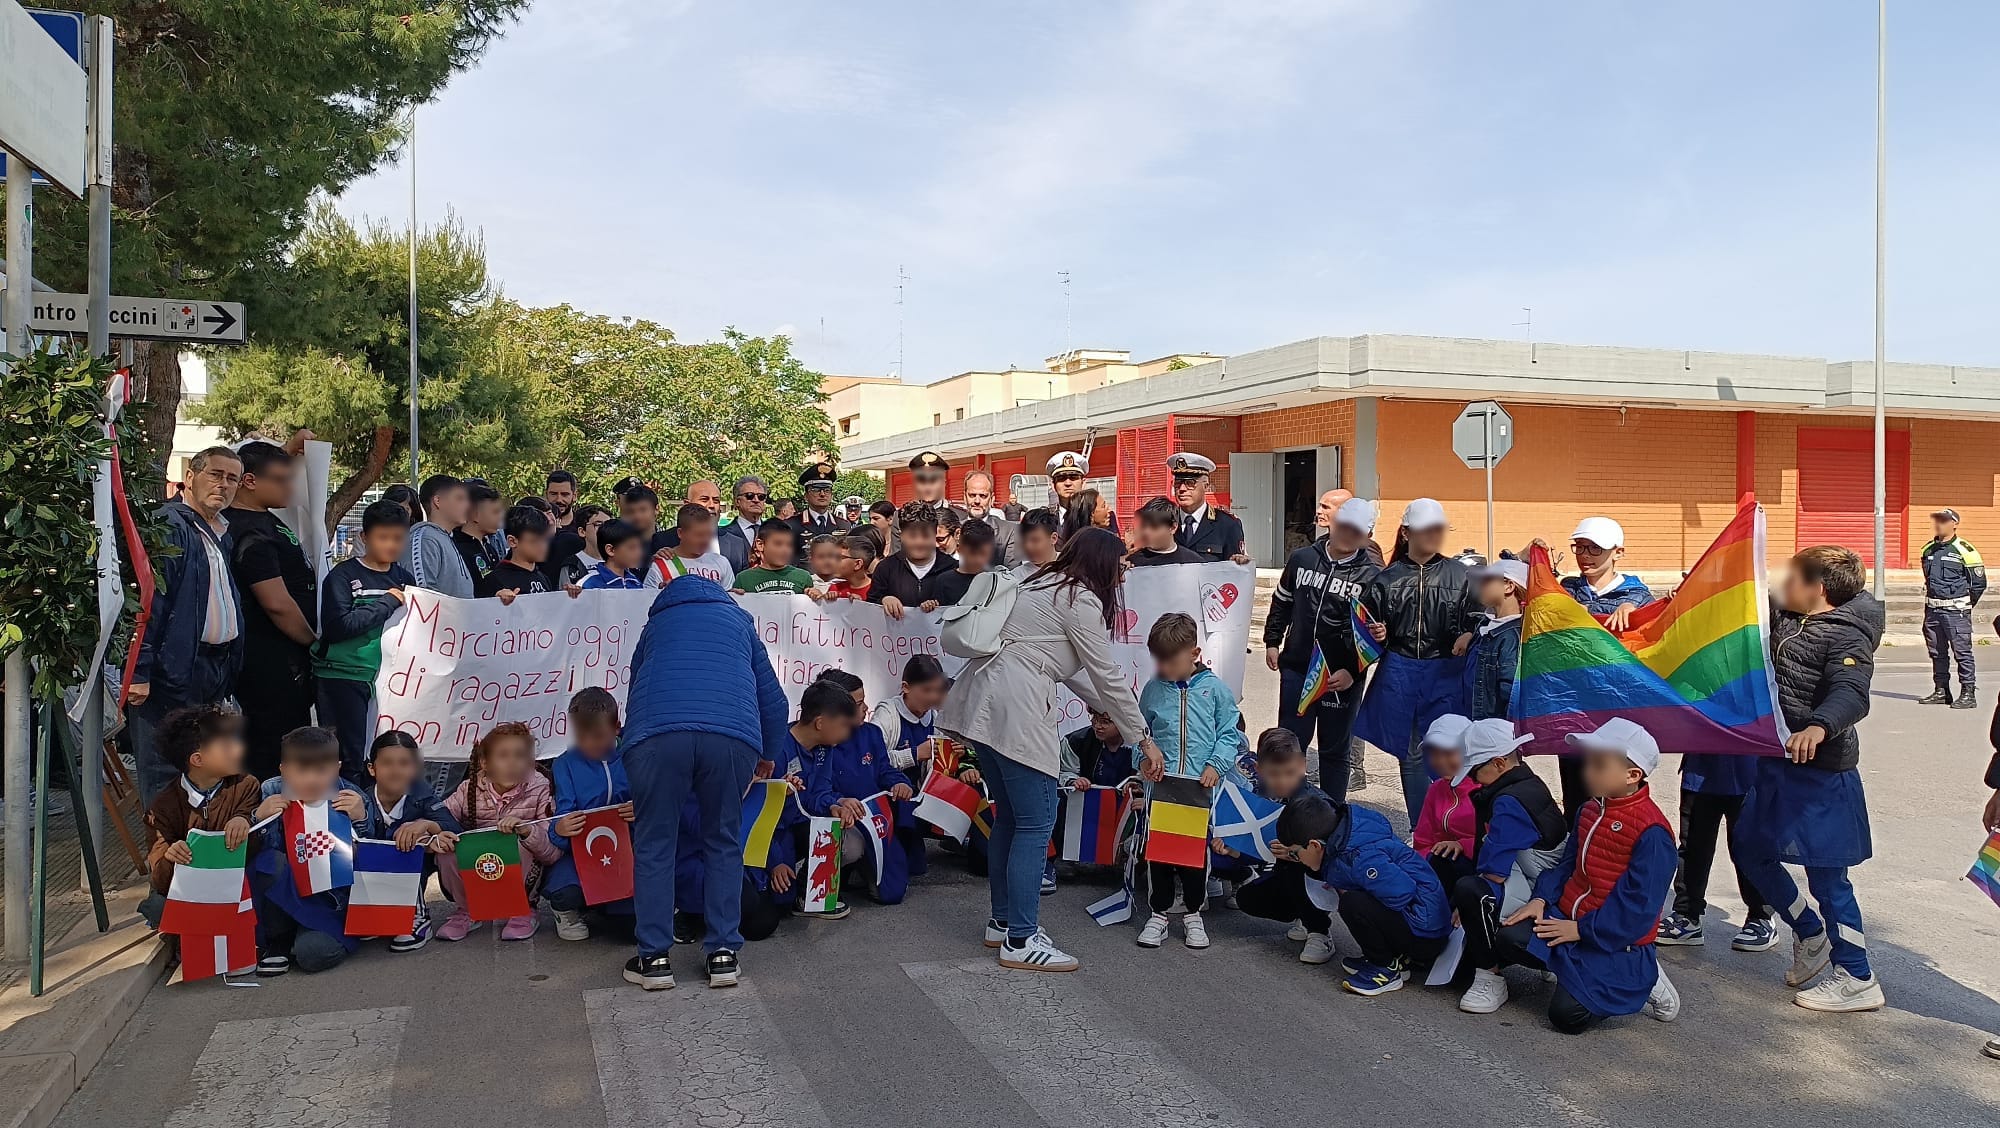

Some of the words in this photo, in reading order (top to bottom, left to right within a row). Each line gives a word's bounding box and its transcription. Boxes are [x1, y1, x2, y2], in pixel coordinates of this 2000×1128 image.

[33, 302, 76, 321] ntro
[86, 306, 157, 325] ccini
[779, 580, 796, 590] STATE
[397, 594, 554, 659] Marciamo
[567, 619, 629, 668] oggi
[791, 611, 873, 649] futura
[881, 635, 946, 677] gene
[387, 656, 426, 699] di
[446, 664, 576, 721] ragazzi
[374, 713, 442, 745] non
[455, 715, 480, 746] in
[497, 704, 567, 739] eda
